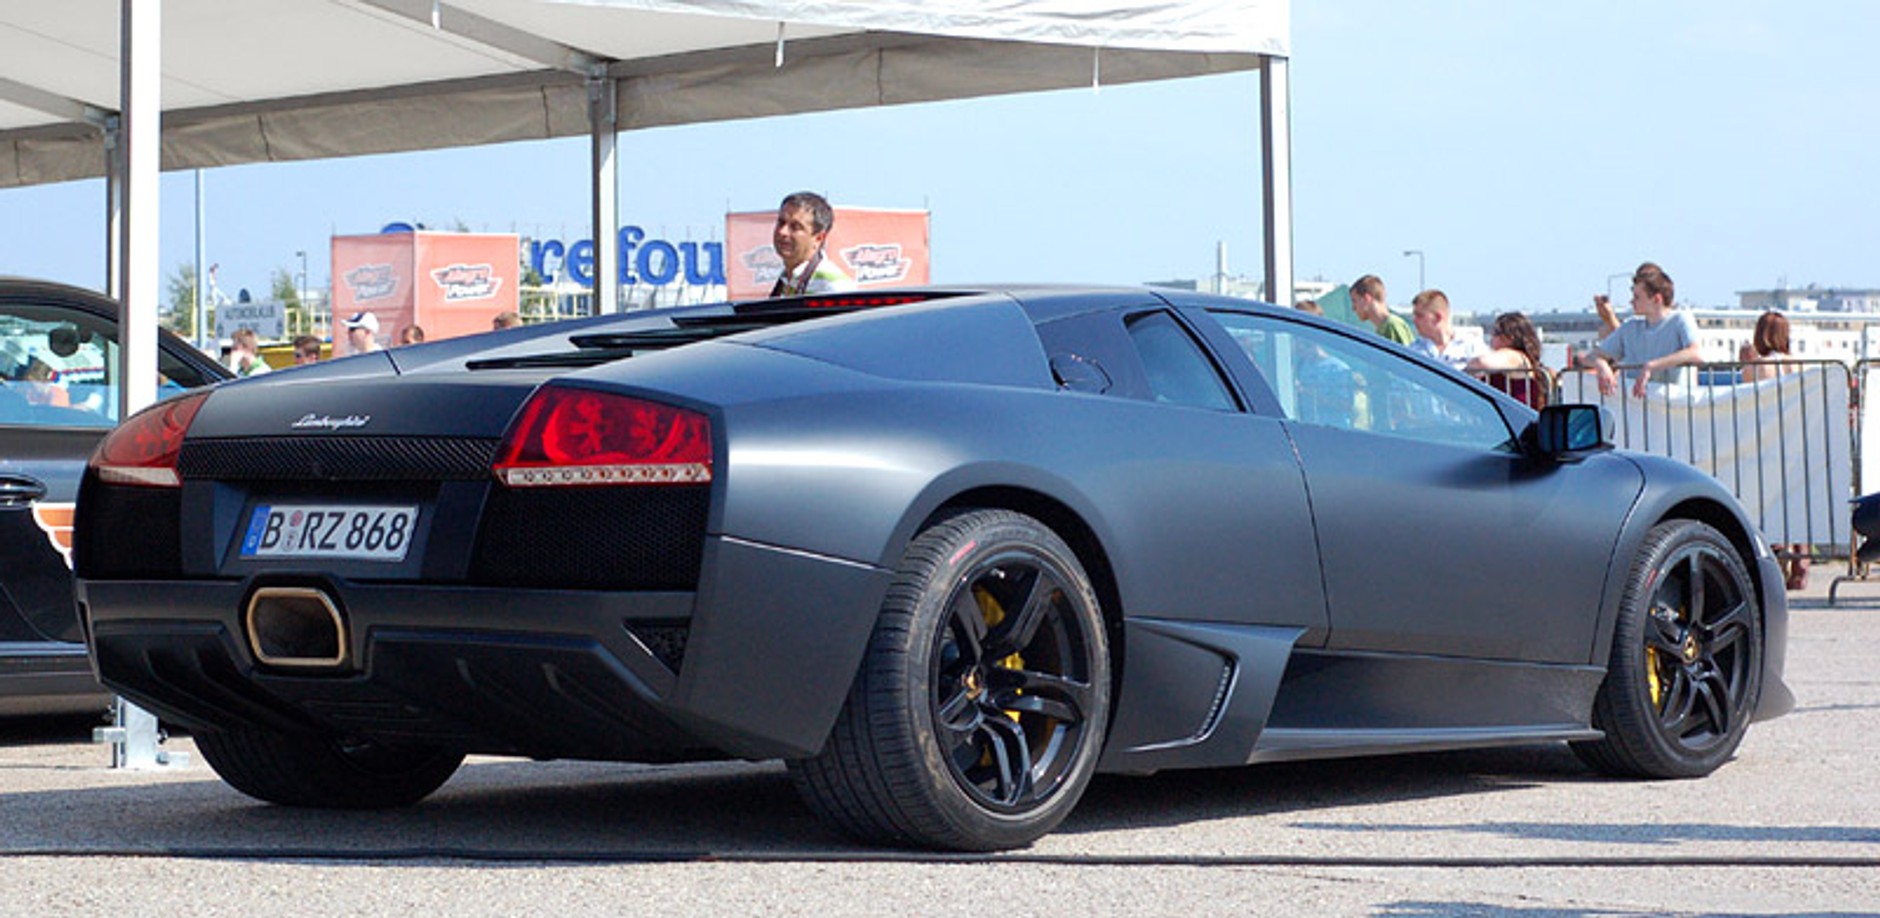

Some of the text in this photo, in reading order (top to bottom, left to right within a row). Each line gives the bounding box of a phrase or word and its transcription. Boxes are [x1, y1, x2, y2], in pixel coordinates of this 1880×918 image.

[531, 225, 727, 286] refou
[260, 511, 409, 551] B RZ 868
